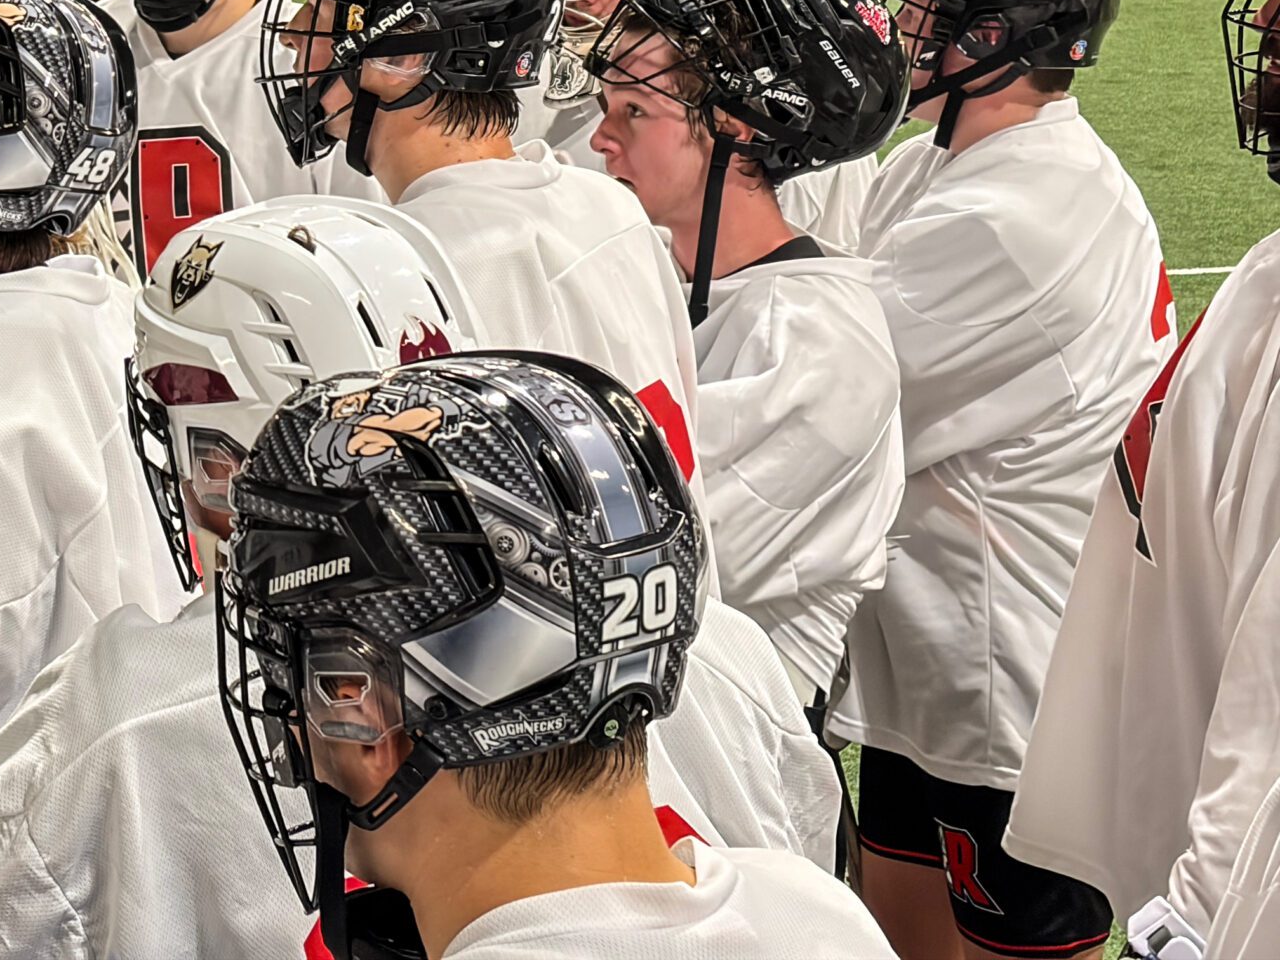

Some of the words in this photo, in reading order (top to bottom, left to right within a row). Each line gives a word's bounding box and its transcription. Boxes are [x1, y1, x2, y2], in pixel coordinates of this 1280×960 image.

[819, 39, 861, 89] BAUER
[66, 147, 117, 184] 48
[268, 556, 352, 596] WARRIOR
[602, 564, 677, 642] 20
[473, 711, 564, 752] ROUGHNECKS
[940, 826, 1005, 916] R
